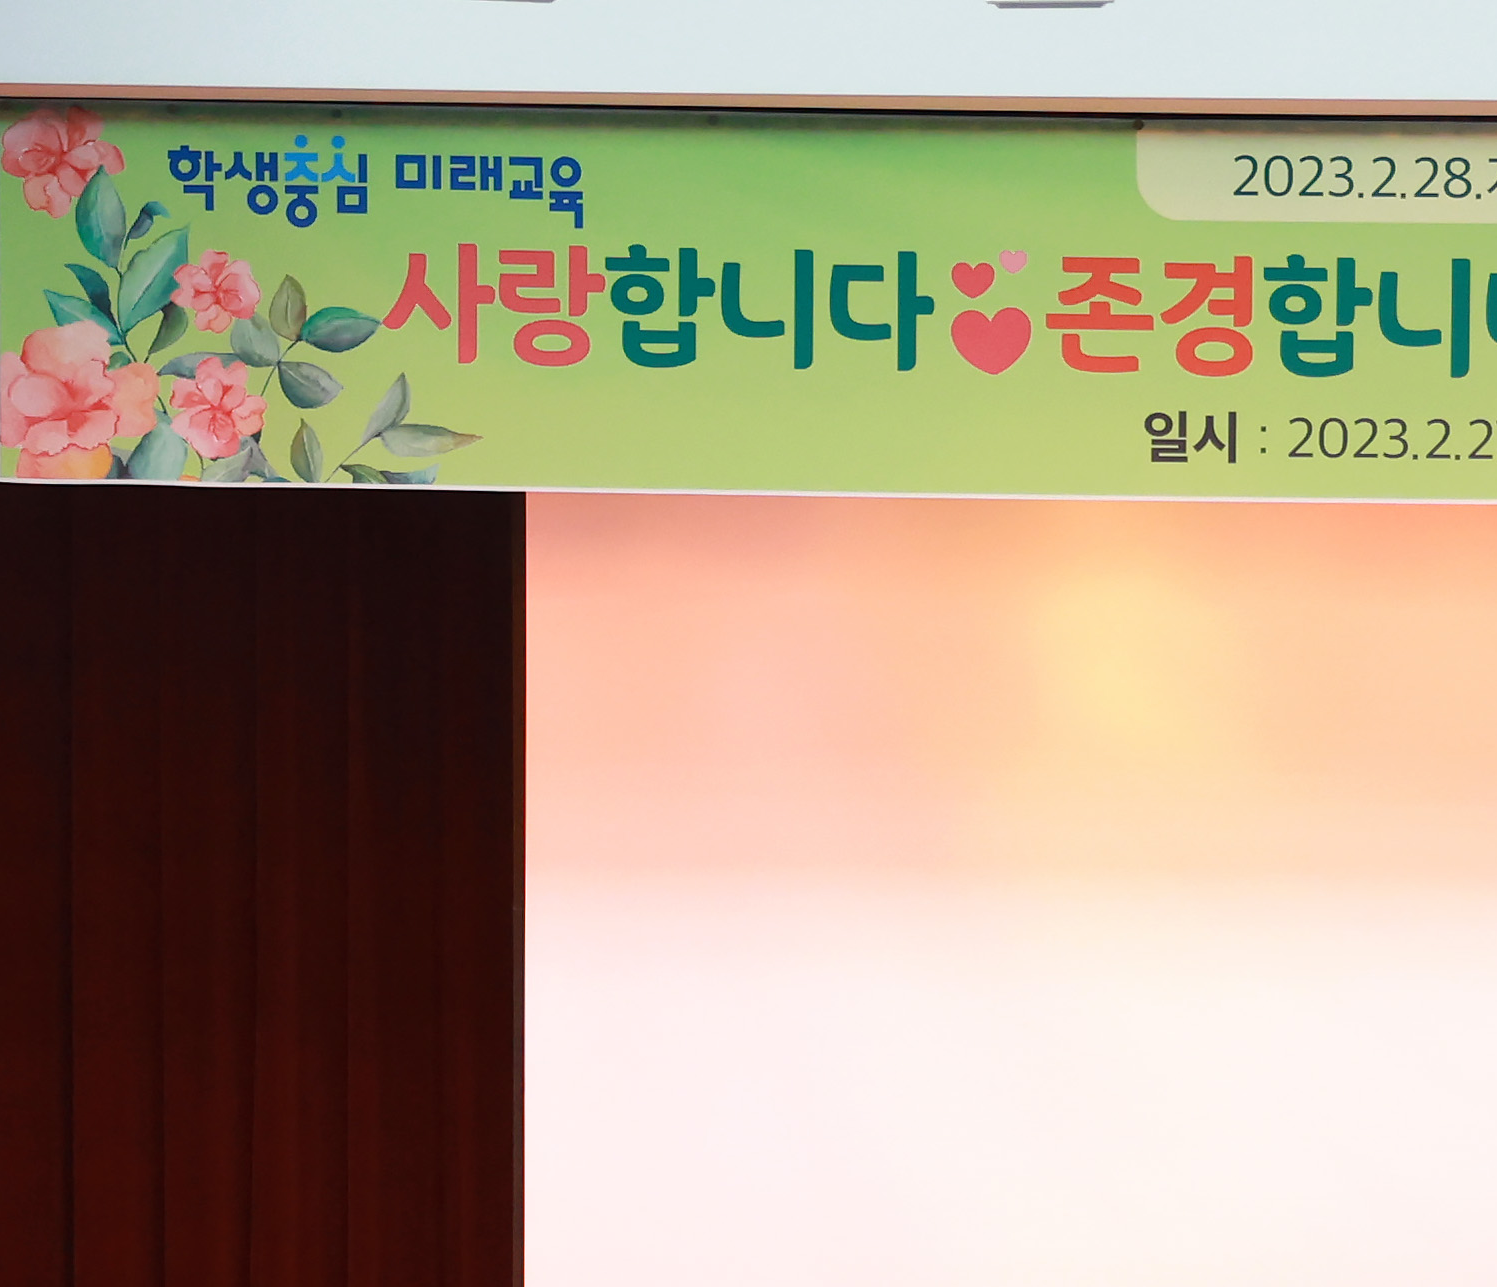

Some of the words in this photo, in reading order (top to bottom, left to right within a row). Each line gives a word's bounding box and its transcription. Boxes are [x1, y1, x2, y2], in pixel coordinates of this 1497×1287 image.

[167, 134, 369, 228] 학생중심
[395, 154, 585, 229] 미래교육
[383, 242, 935, 373] 사랑합니다
[1143, 410, 1238, 463] 일시
